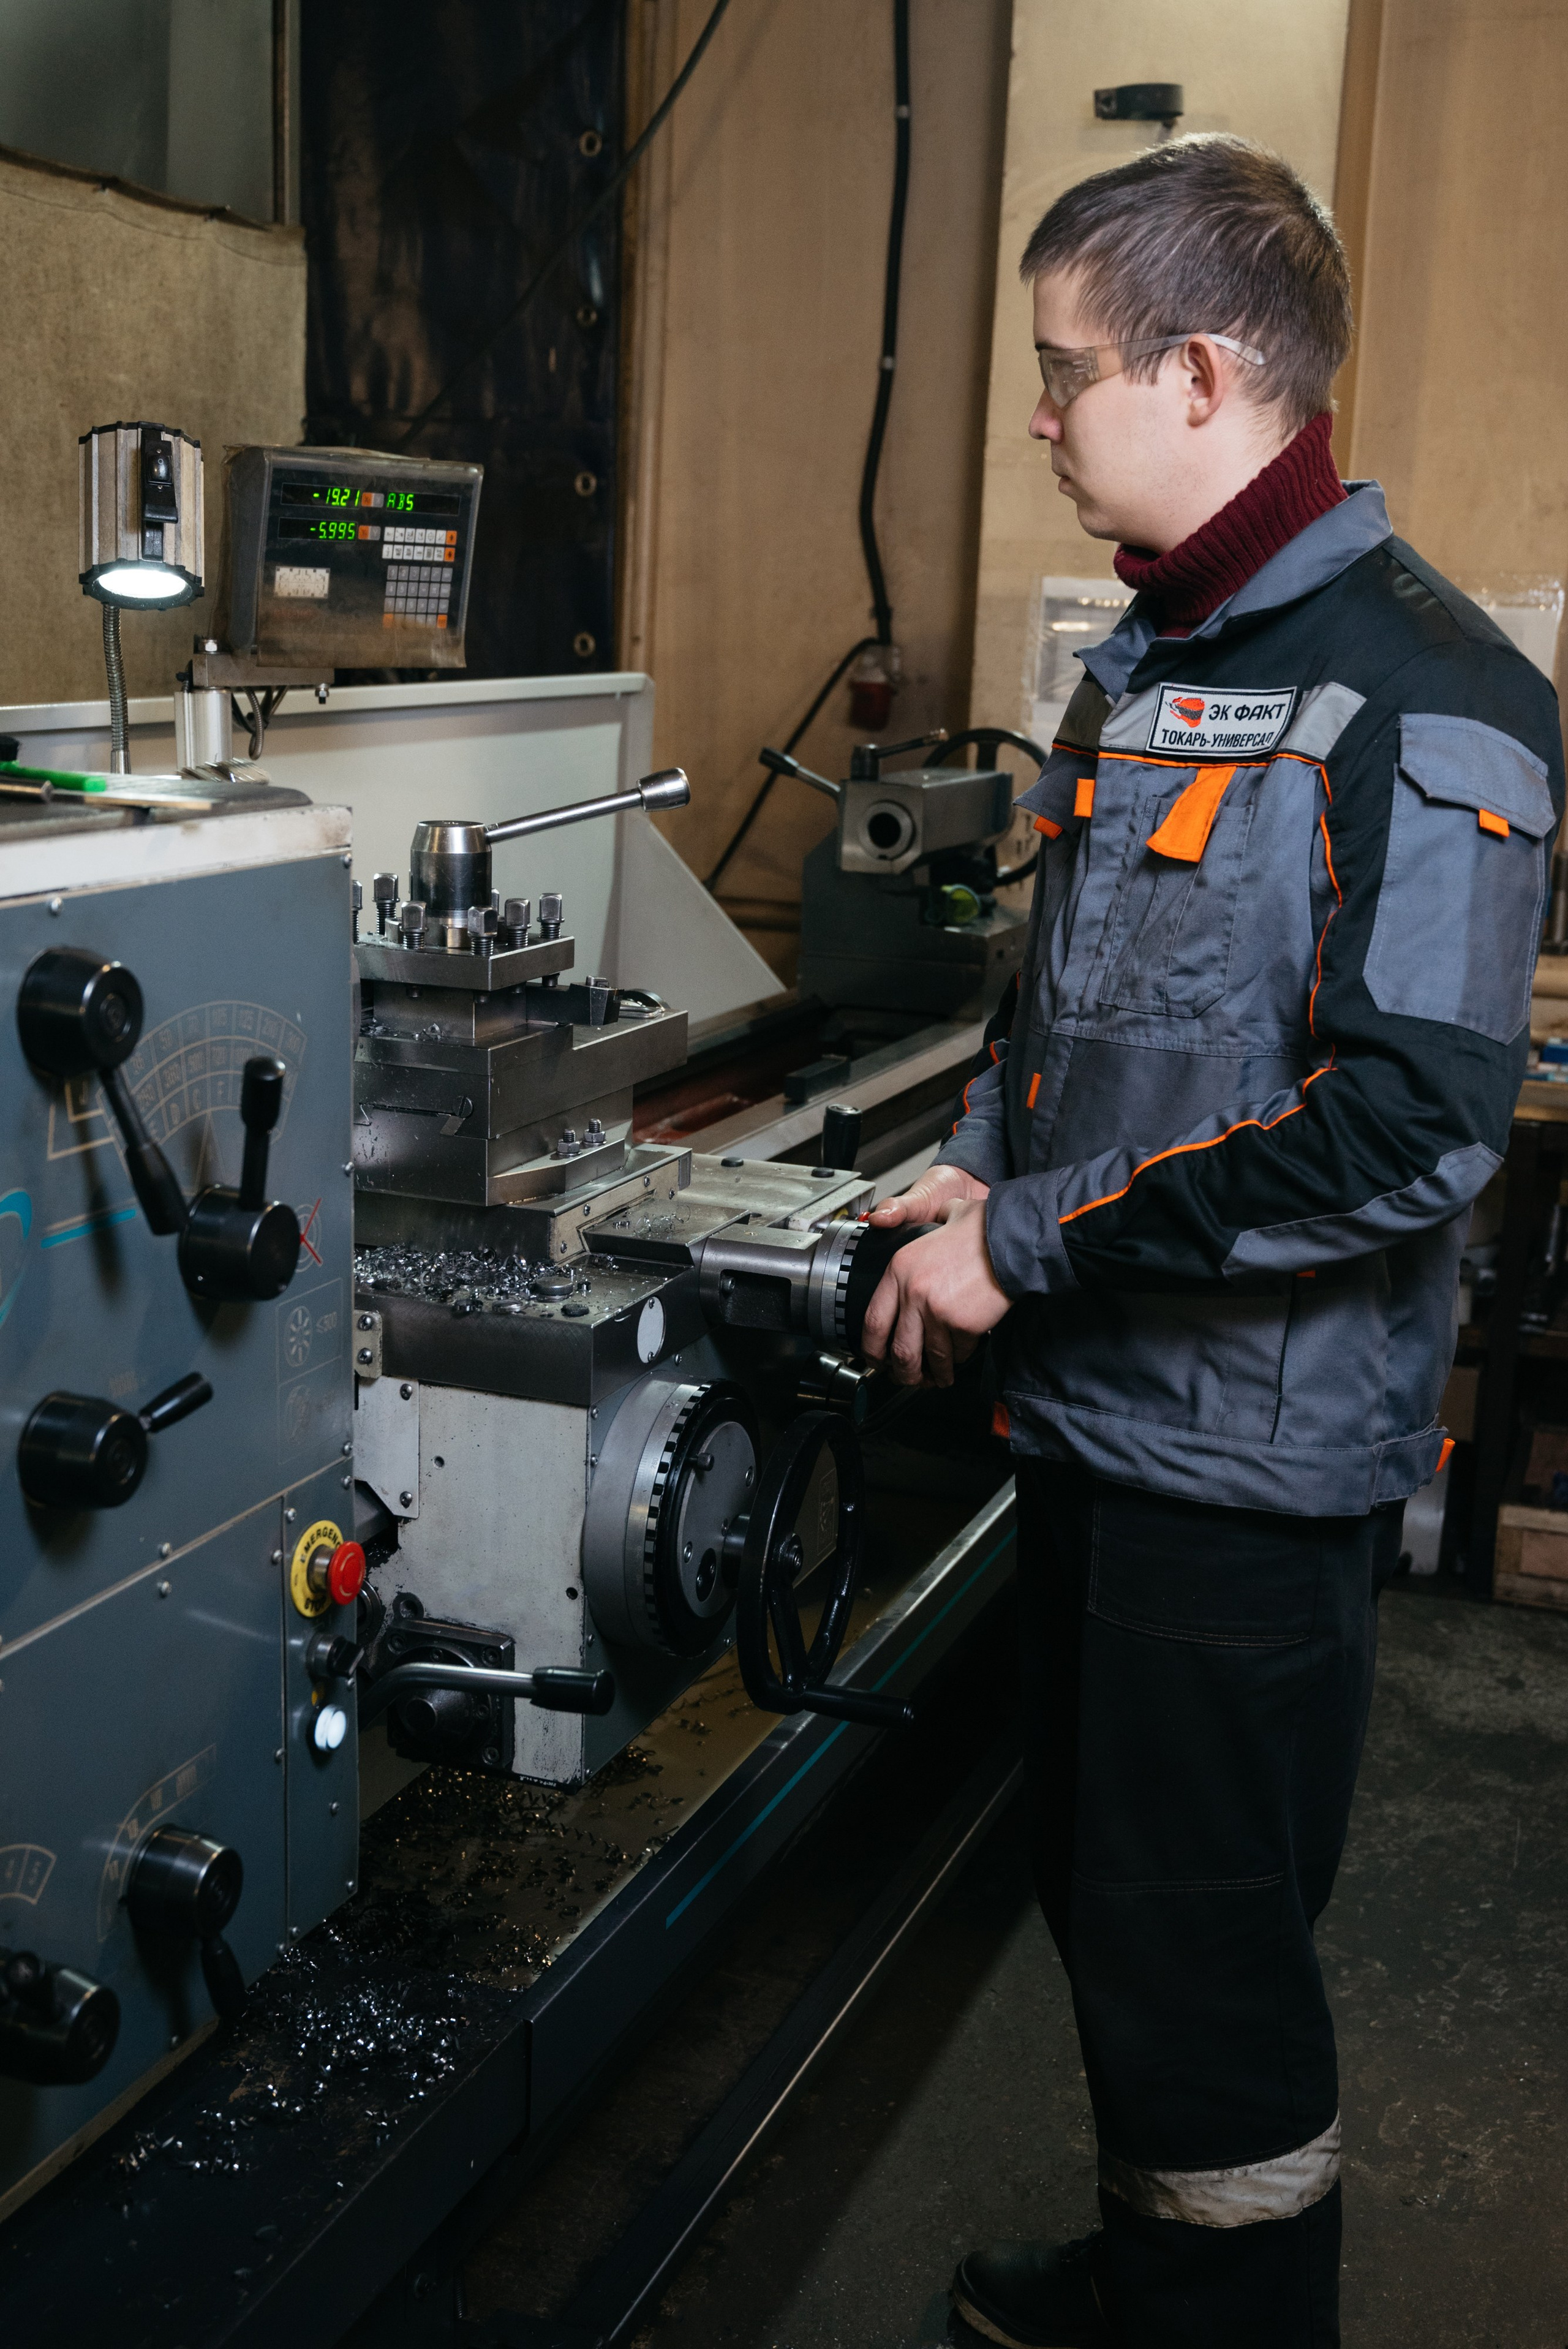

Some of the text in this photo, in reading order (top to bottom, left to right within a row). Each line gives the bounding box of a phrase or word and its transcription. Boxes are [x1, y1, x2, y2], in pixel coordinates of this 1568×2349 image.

[386, 492, 415, 511] ABS
[1208, 703, 1286, 721] ЭК ФАКТ
[1161, 728, 1275, 748] ТОКАРЬ-УНИВЕРСАЛ
[300, 1526, 341, 1564] EMERGENC
